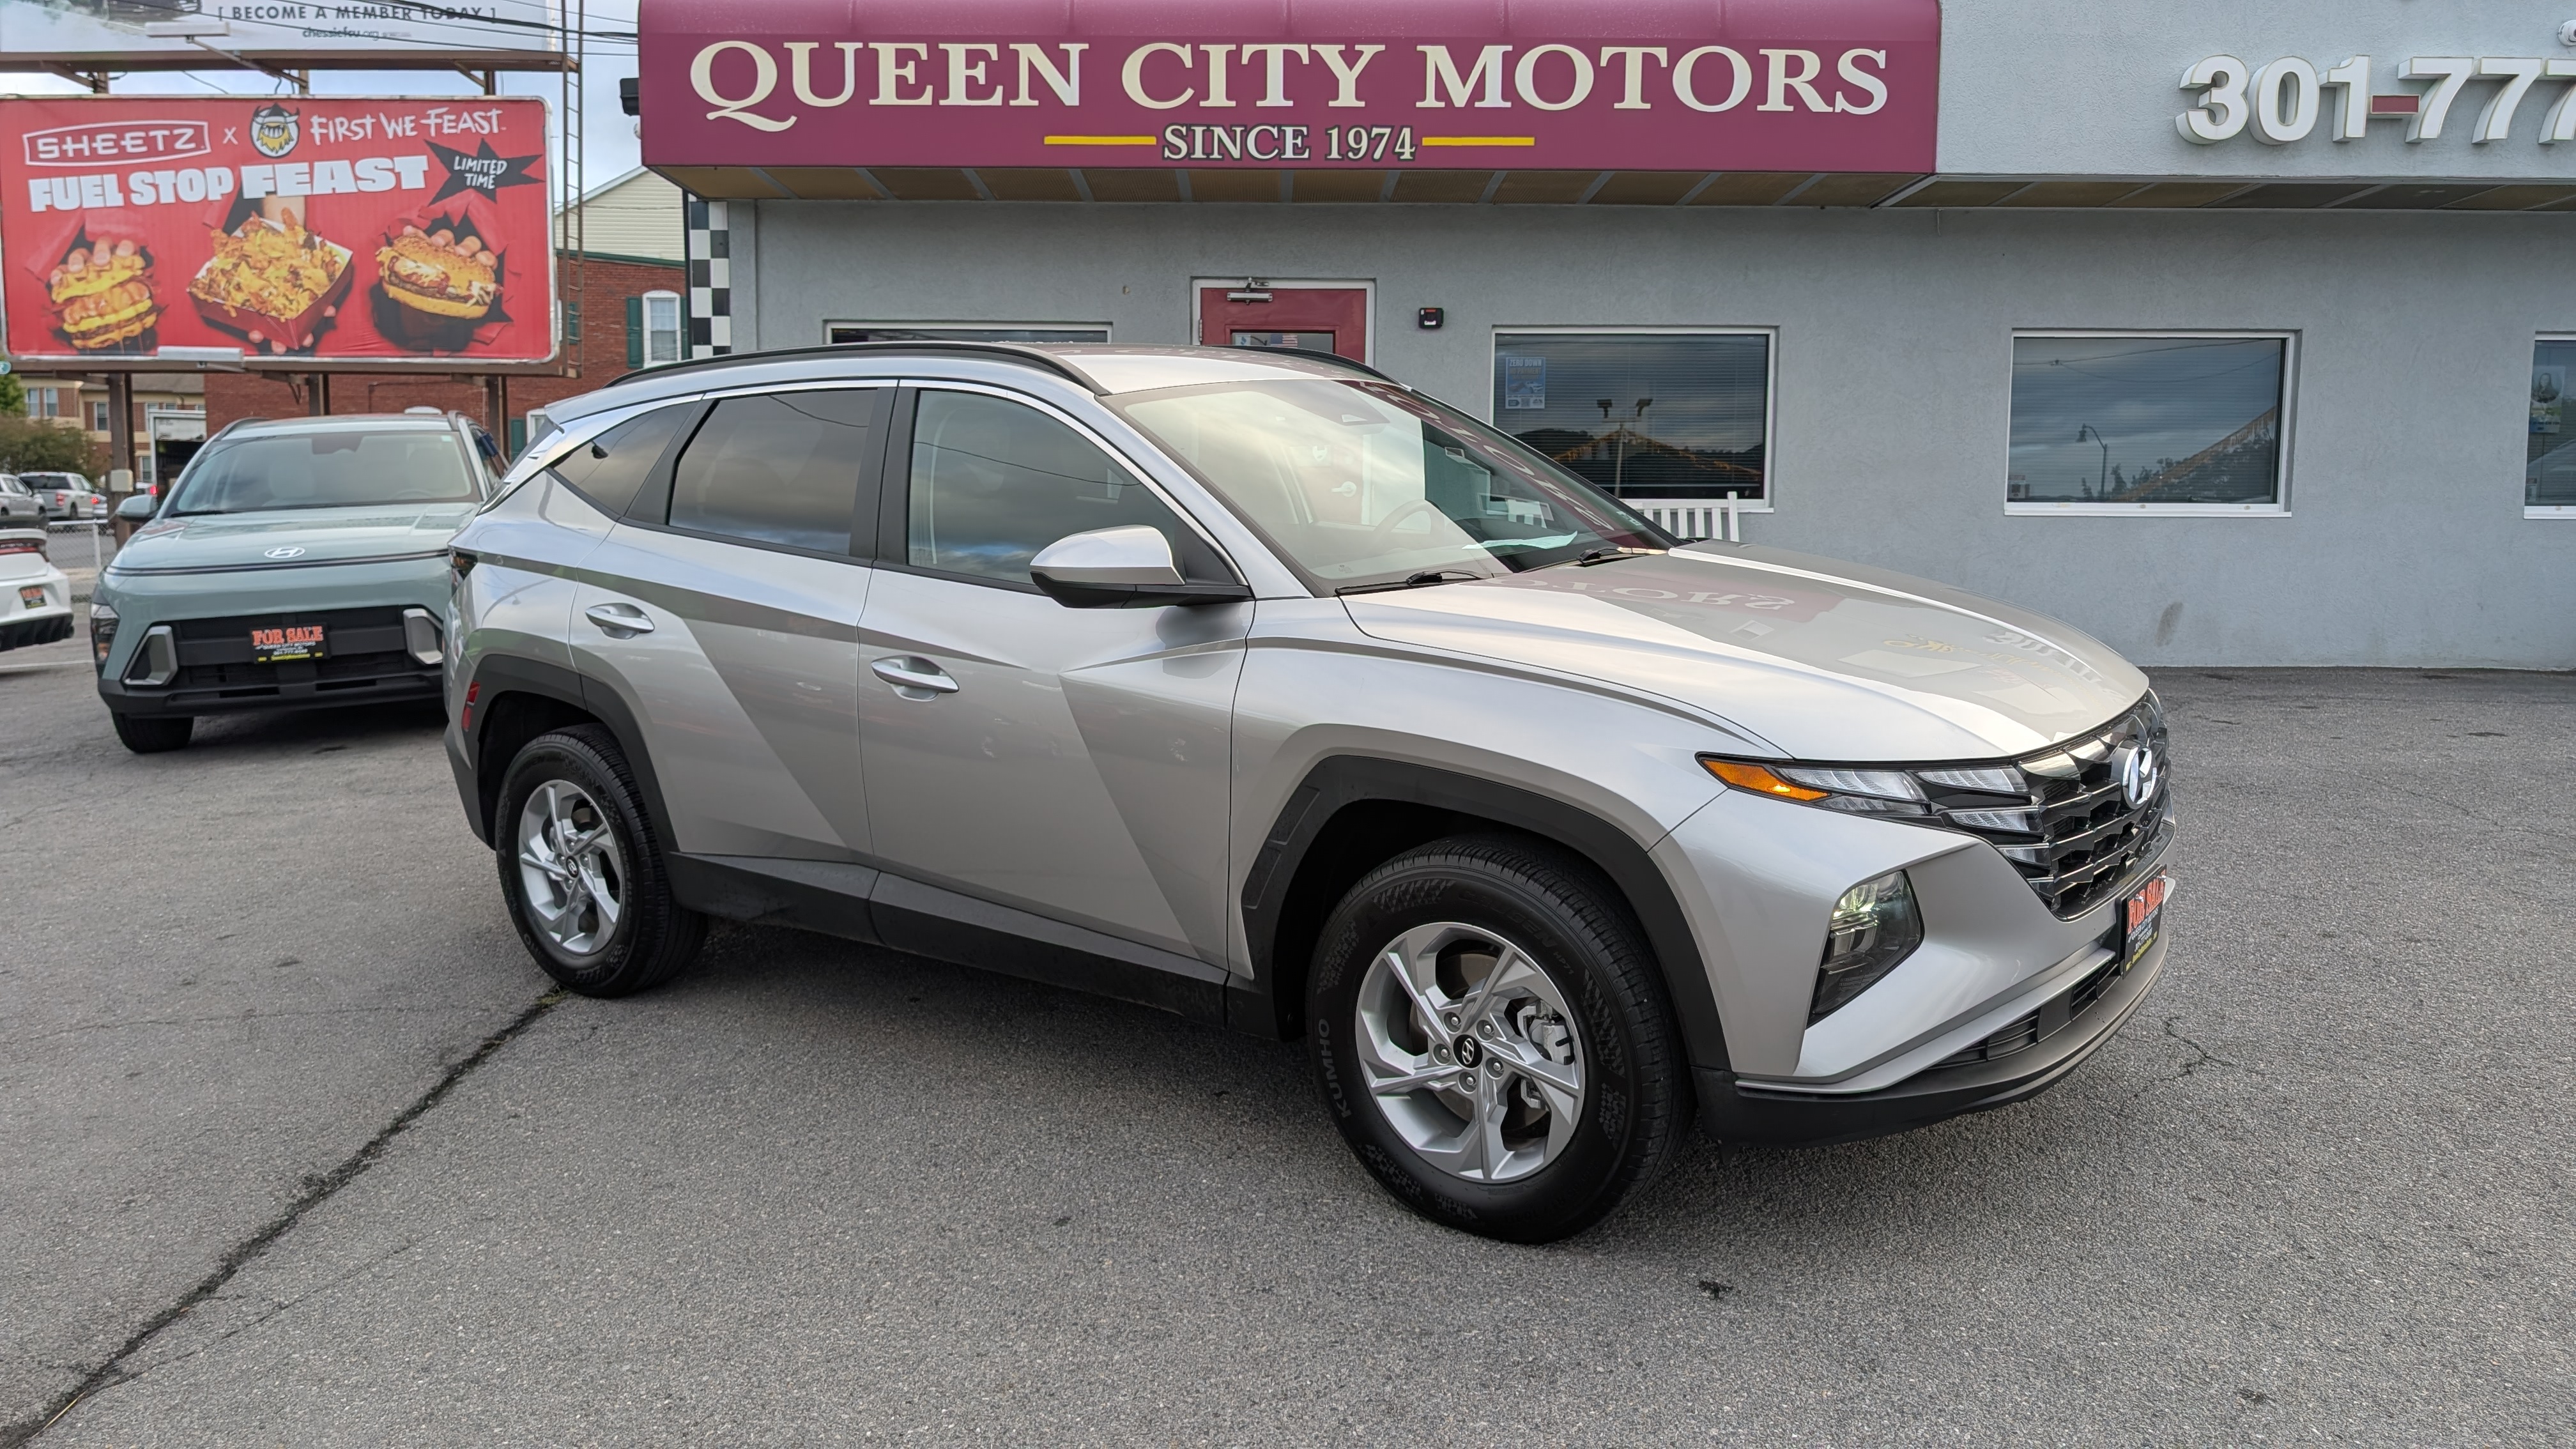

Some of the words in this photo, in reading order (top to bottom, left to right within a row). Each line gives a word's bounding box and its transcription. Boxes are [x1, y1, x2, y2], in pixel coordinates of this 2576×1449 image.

[233, 6, 307, 20] BECOME
[314, 6, 328, 20] A
[335, 6, 412, 20] MEMBER
[689, 40, 1089, 132] QUEEN
[1121, 42, 1386, 110] CITY
[1415, 44, 1888, 116] MOTORS
[36, 128, 197, 159] SHEETZ
[310, 112, 376, 146] FIRST
[379, 112, 418, 139] WE
[420, 107, 503, 137] FEAST
[1163, 124, 1310, 160] SINCE
[1324, 125, 1417, 160] 1974
[28, 173, 125, 212] FUEL
[128, 167, 234, 205] STOP
[240, 155, 429, 199] FEAST
[453, 155, 508, 175] LIMITED
[464, 172, 496, 189] TIME
[252, 629, 285, 647] FOR
[286, 625, 324, 643] SALE
[2127, 889, 2146, 935] FOR
[1318, 1018, 1352, 1118] KUMHO
